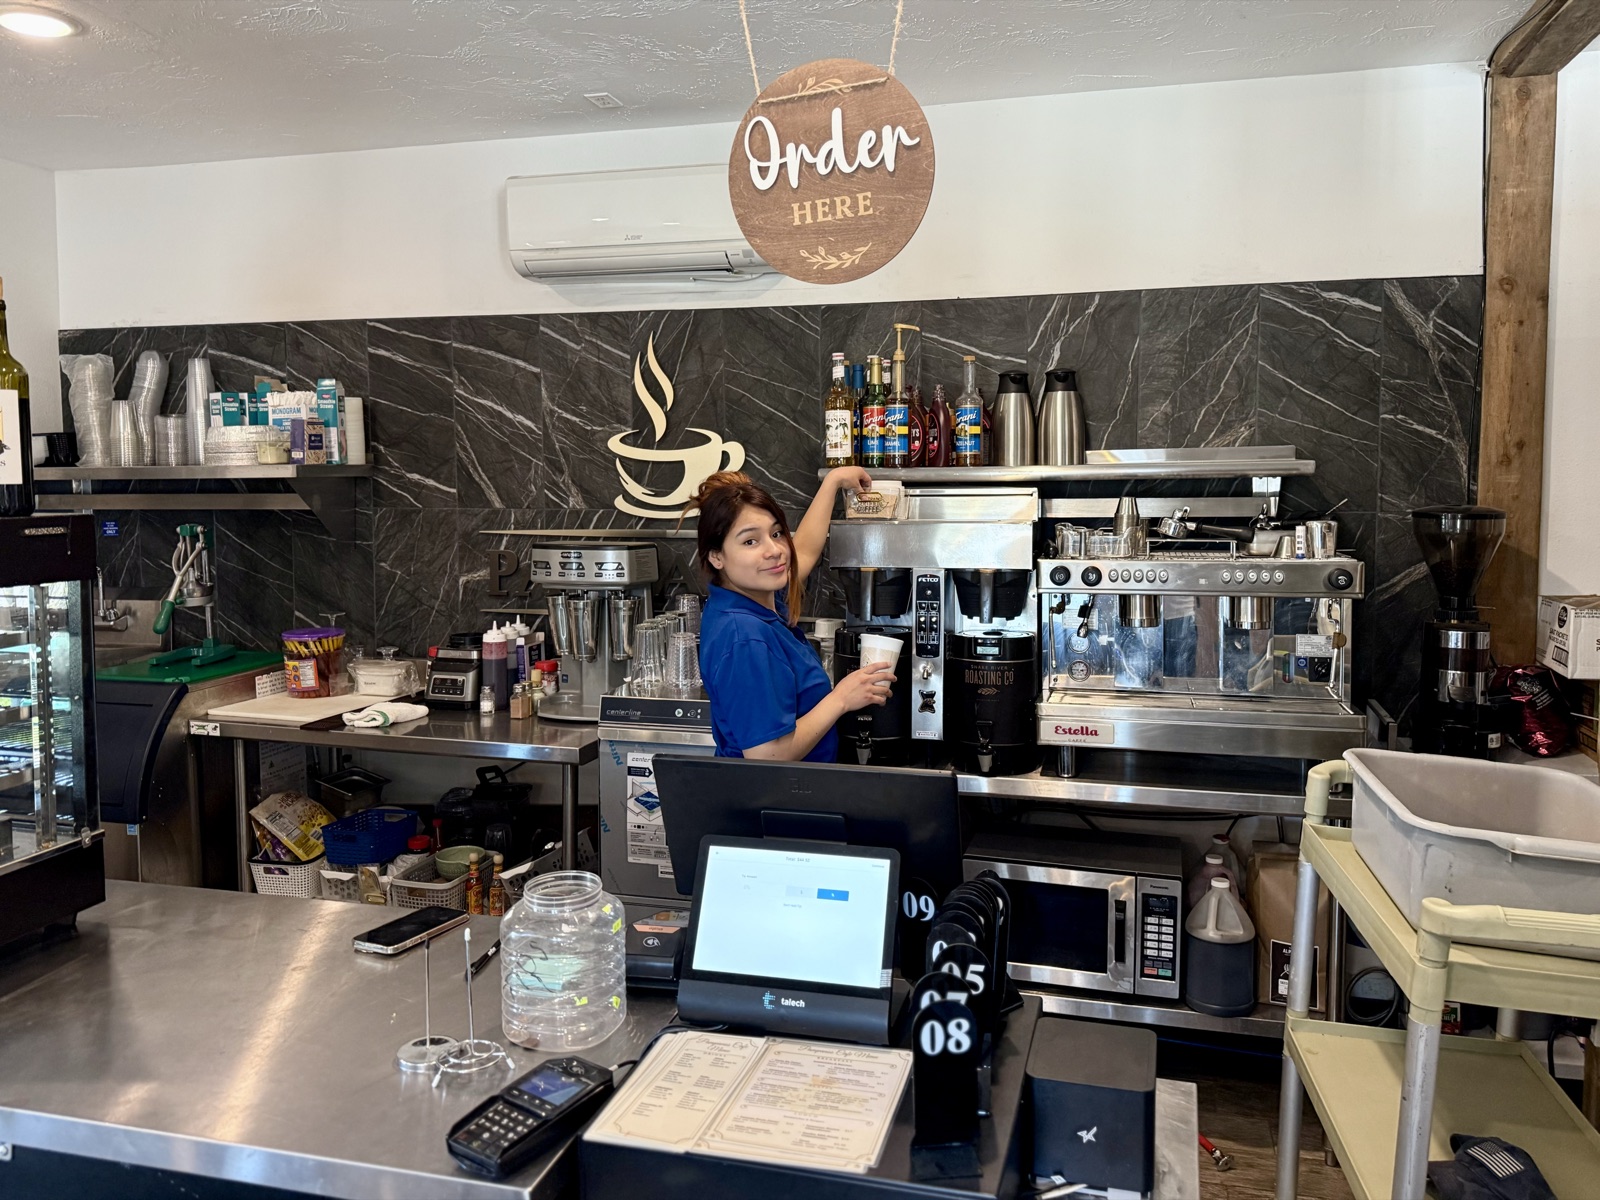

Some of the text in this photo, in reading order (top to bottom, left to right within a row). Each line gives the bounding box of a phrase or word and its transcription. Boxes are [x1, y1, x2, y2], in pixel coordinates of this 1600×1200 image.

[744, 107, 920, 190] Order
[791, 192, 874, 226] HERE
[271, 407, 302, 415] MONOGRAM
[863, 411, 885, 425] Toran
[965, 670, 1001, 686] ROASTING
[606, 708, 641, 717] centerline
[1054, 725, 1100, 736] Estella
[608, 740, 624, 766] Nitt
[902, 891, 935, 921] 09
[781, 997, 805, 1008] talech
[919, 1018, 971, 1056] 08
